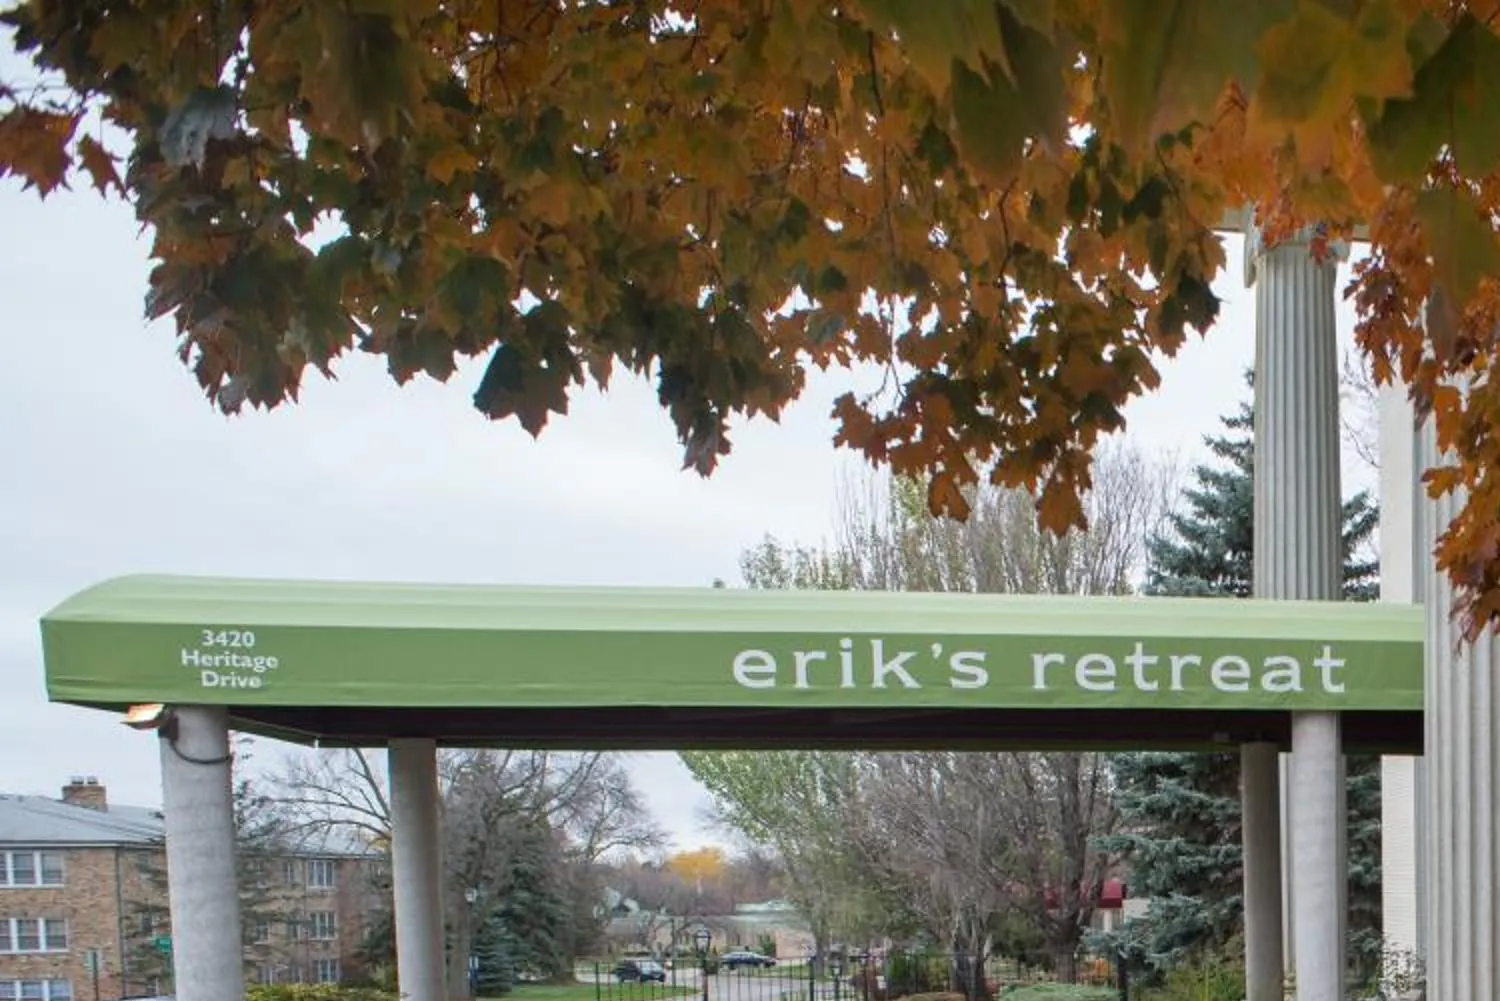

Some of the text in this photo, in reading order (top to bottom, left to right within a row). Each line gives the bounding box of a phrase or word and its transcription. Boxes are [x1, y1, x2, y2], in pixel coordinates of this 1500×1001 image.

[201, 629, 256, 648] 3420
[180, 648, 280, 673] Heritage
[732, 637, 1347, 693] erik's retreat
[201, 670, 263, 689] Drive
